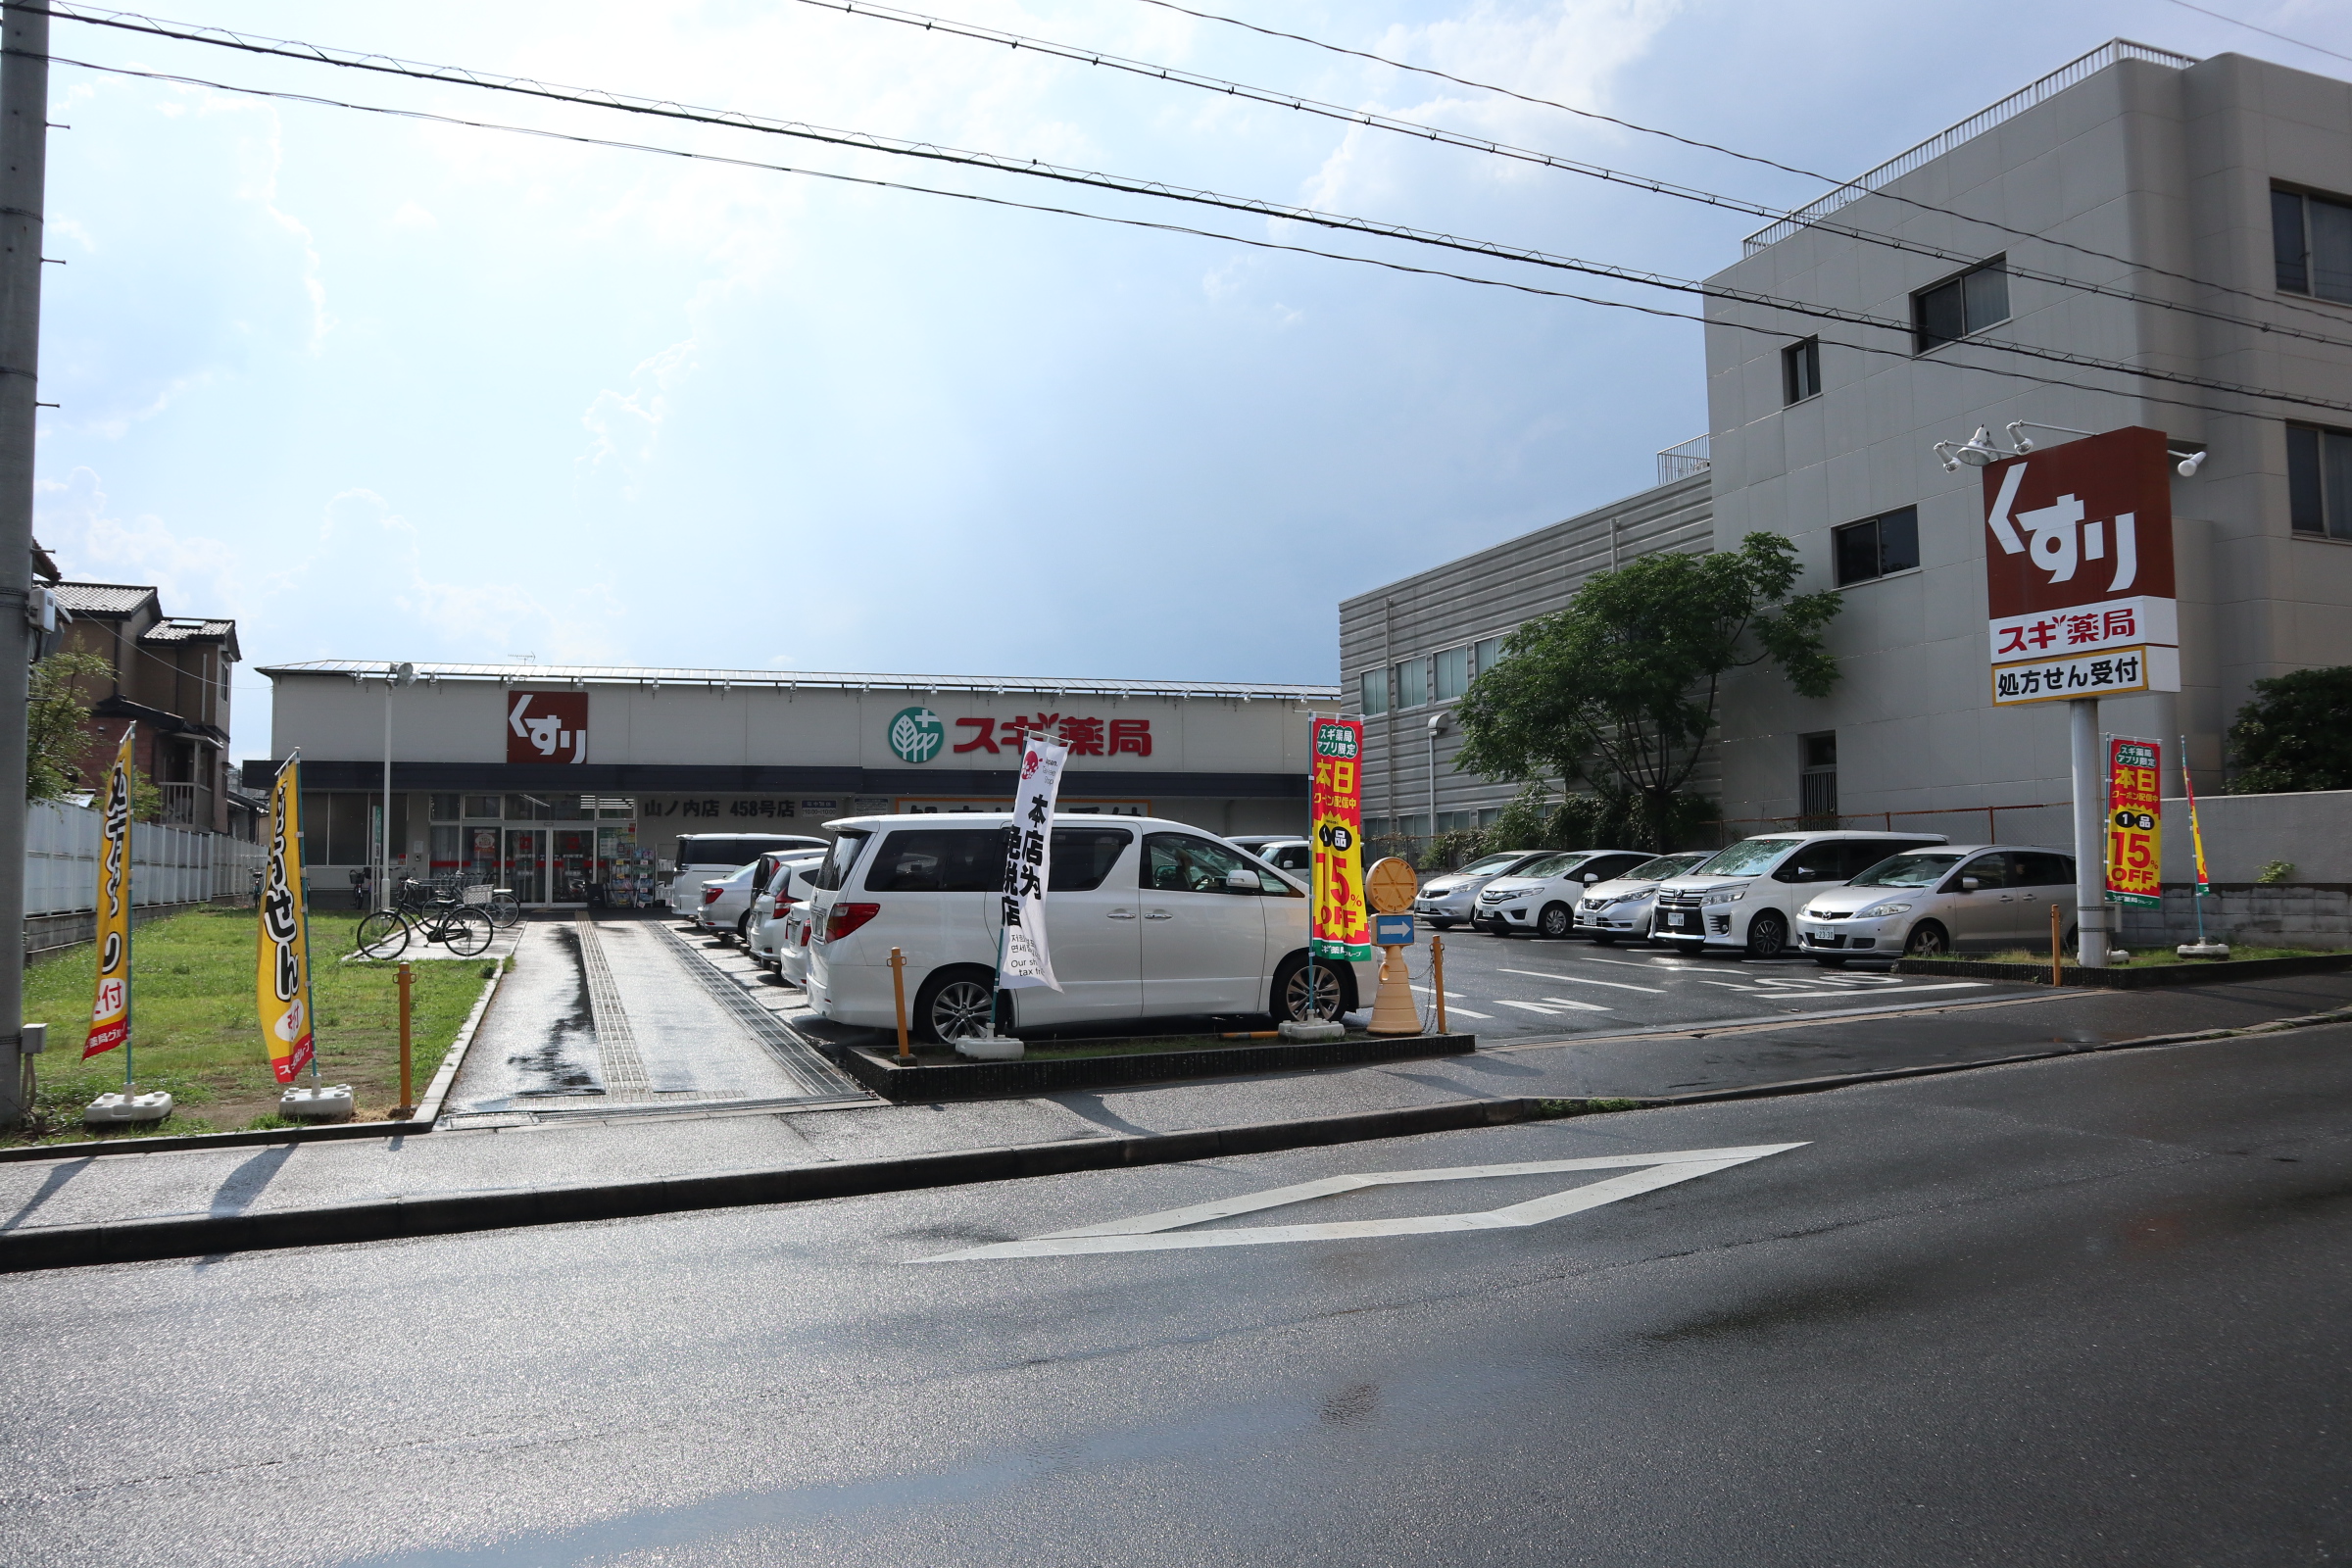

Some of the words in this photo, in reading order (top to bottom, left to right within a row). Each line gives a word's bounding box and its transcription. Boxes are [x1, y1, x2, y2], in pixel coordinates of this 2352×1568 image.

[1988, 462, 2136, 592] くすり
[1998, 608, 2135, 655] スギ薬局
[1998, 656, 2138, 697] 処方せん受付
[509, 694, 587, 764] くすり
[953, 711, 1152, 758] スギ薬局
[1320, 728, 1353, 743] スギ薬局
[1317, 741, 1356, 757] アプリ限定
[2120, 745, 2153, 759] スギ薬局
[1315, 758, 1355, 795] 本日
[2114, 767, 2156, 793] 本日
[644, 799, 720, 818] 山ノ内店
[730, 800, 796, 819] 458号店
[1019, 794, 1049, 901] 本店为
[2110, 867, 2154, 885] OFF
[1320, 905, 1357, 929] OFF
[1010, 959, 1027, 968] Our
